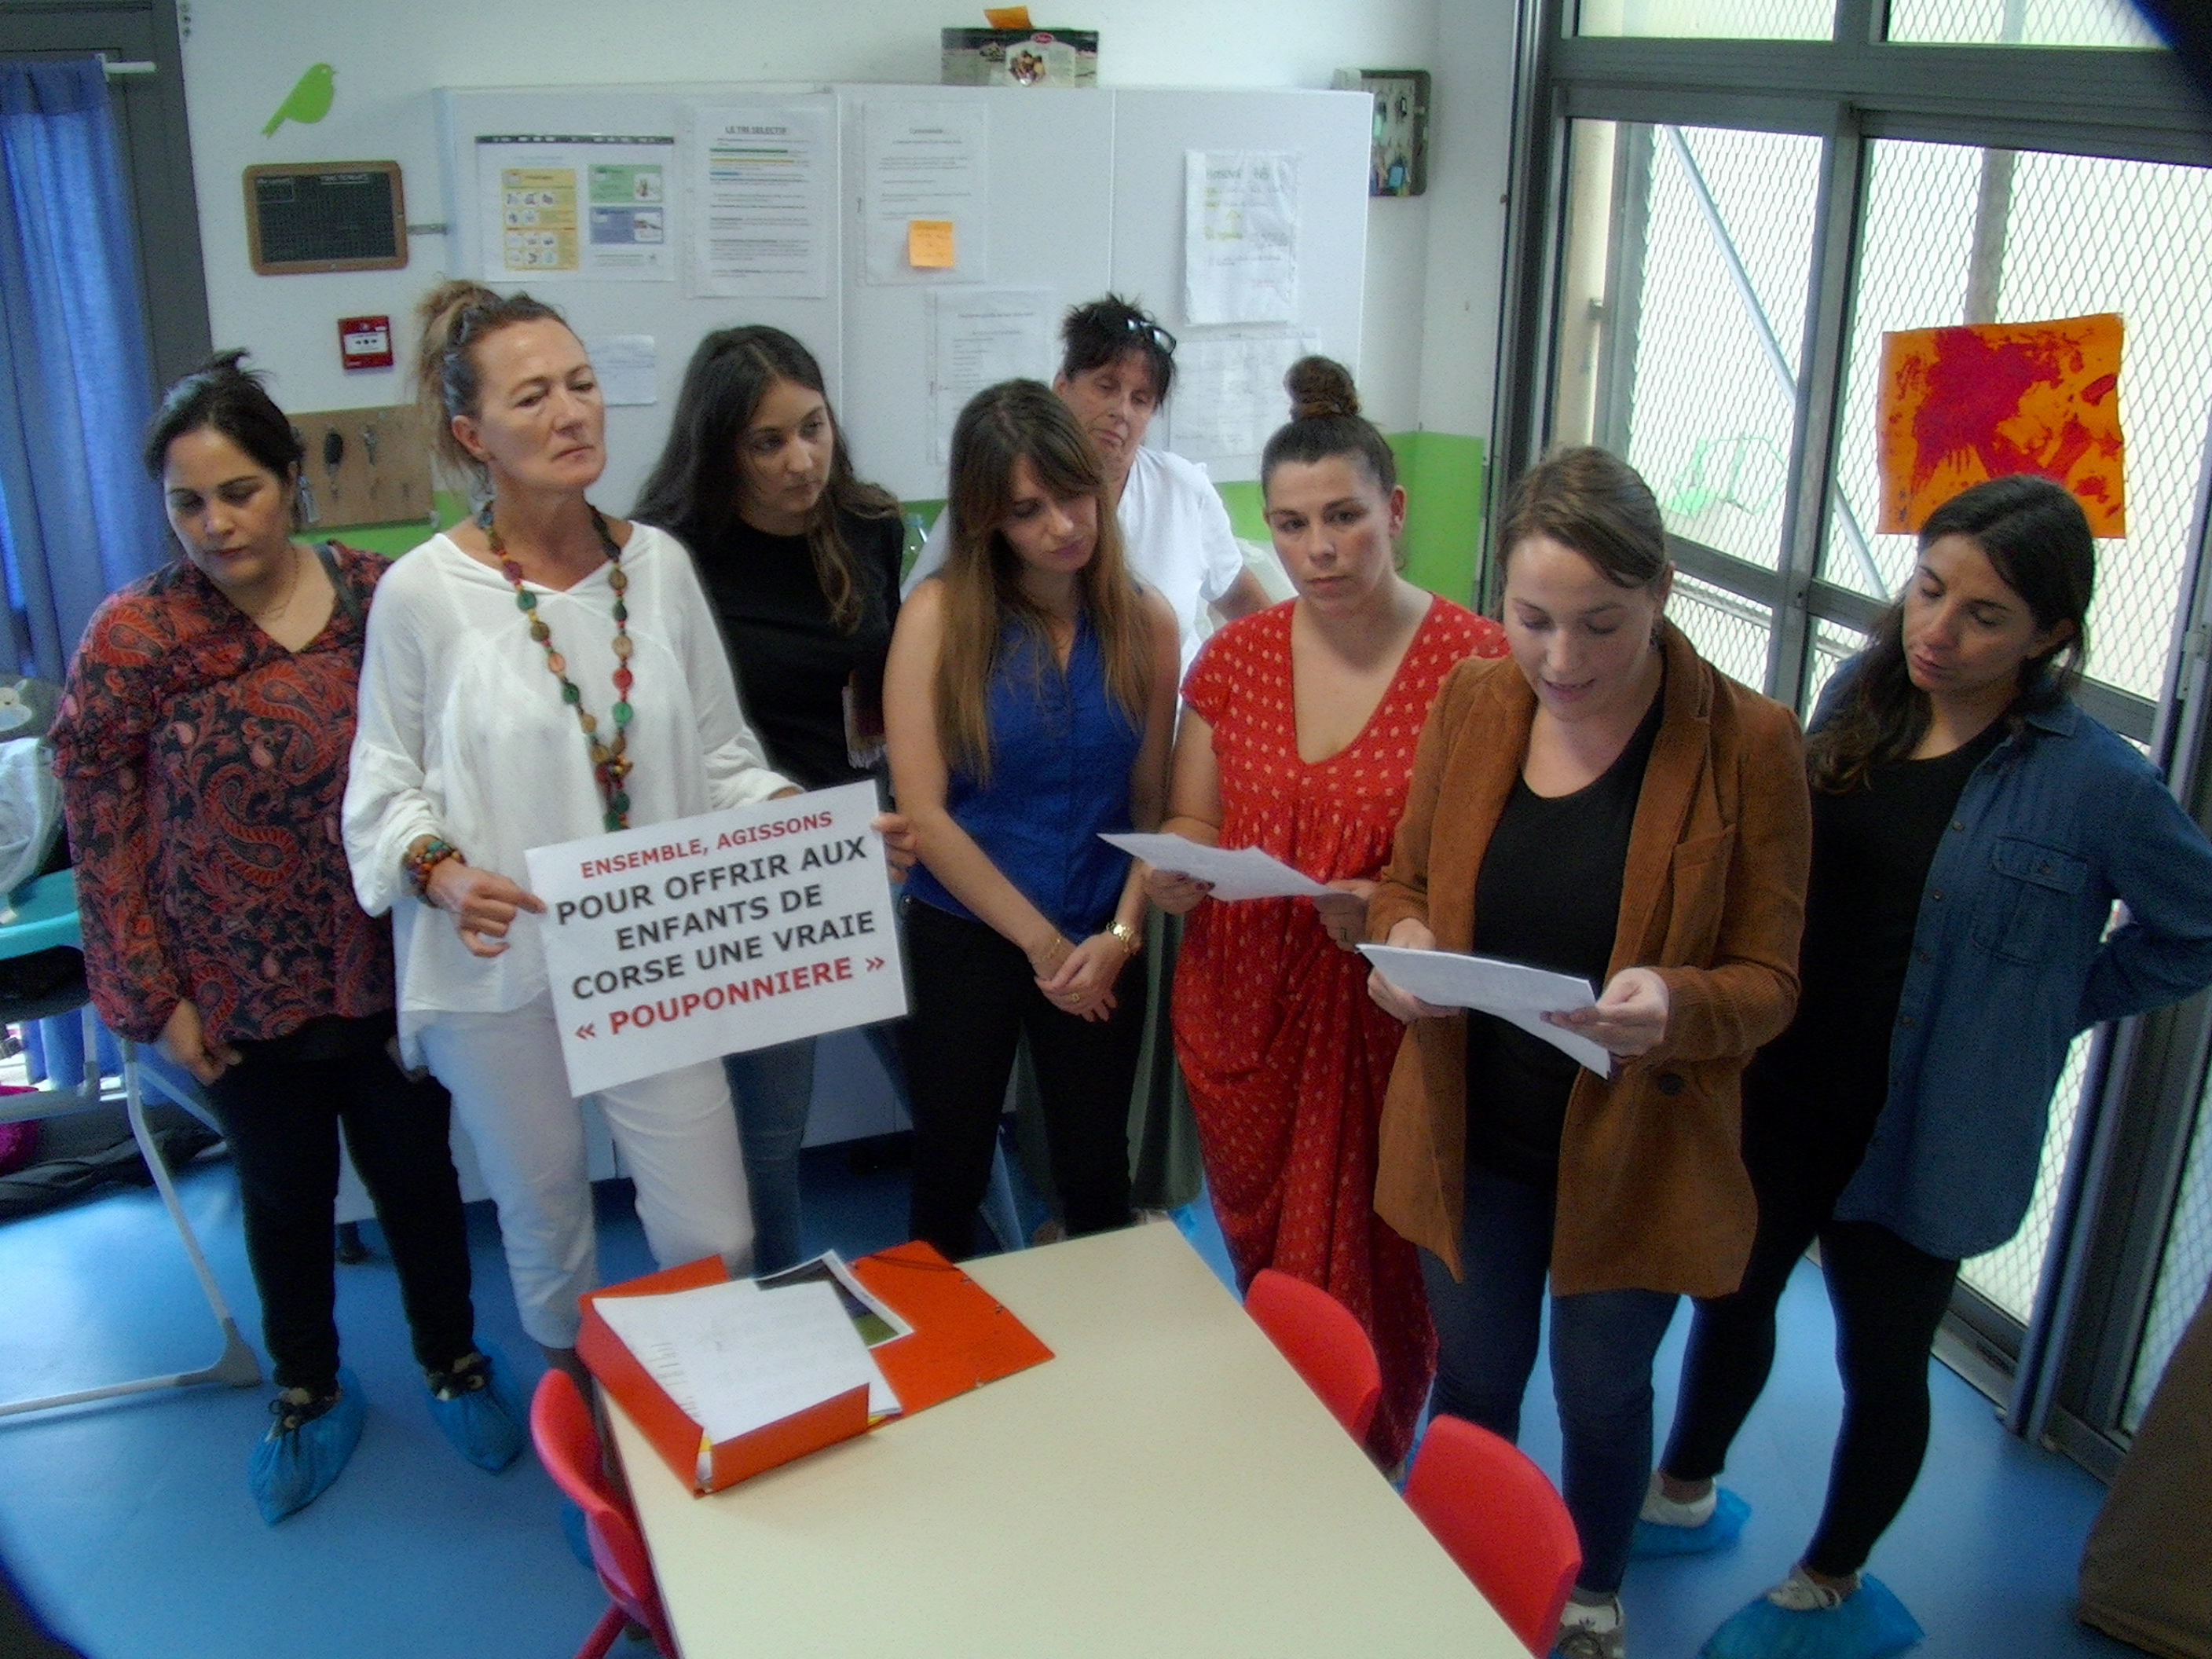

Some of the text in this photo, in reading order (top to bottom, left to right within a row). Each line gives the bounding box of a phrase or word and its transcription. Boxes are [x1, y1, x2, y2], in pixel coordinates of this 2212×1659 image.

[724, 126, 735, 134] LE
[555, 836, 867, 925] POUR OFFRIR AUX
[580, 811, 833, 879] ENSEMBLE, AGISSONS
[572, 910, 875, 1000] CORSE UNE VRAIE
[616, 883, 823, 951] ENFANTS DE
[575, 956, 885, 1040] « POUPONNIERE »
